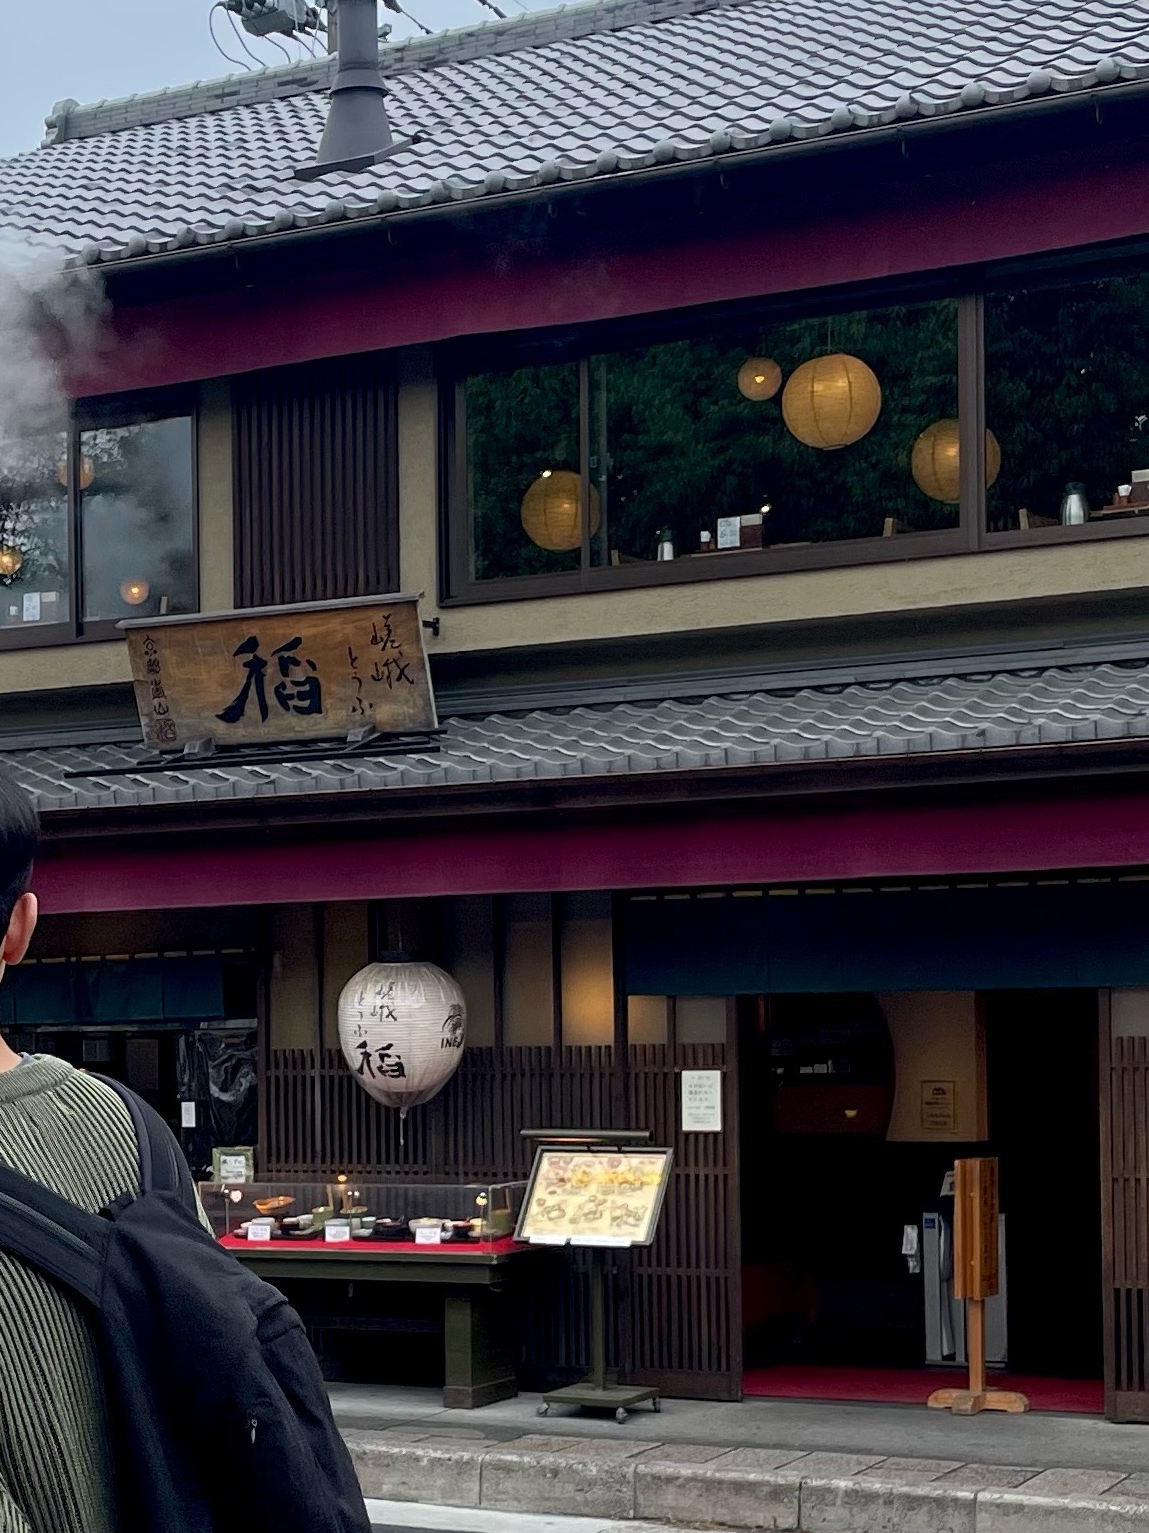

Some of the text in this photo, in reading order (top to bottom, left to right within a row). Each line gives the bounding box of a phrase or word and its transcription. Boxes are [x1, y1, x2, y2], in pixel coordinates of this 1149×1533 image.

[348, 645, 373, 716] とうふ
[370, 613, 415, 689] 嵯峨
